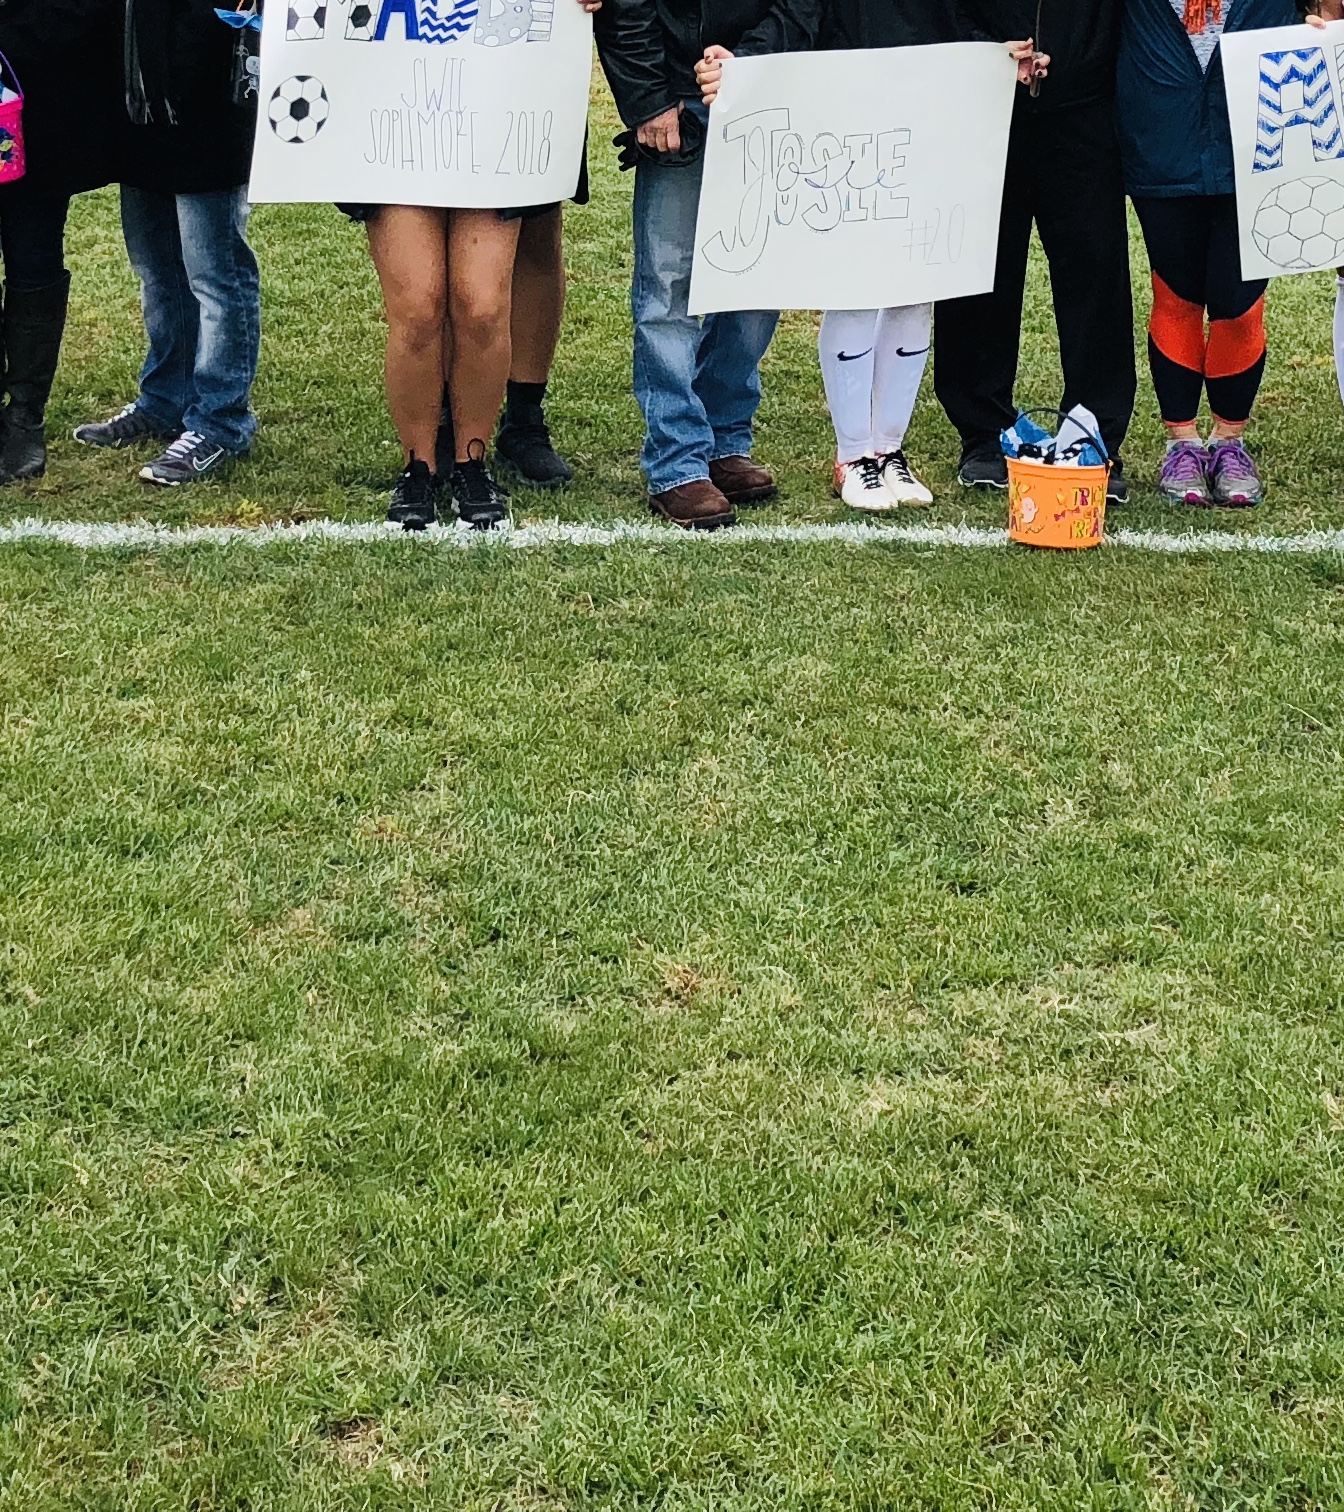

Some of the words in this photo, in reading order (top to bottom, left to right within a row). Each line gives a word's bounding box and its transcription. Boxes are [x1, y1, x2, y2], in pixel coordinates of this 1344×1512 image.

[400, 57, 467, 115] SWIC
[494, 109, 554, 176] 2018
[901, 203, 965, 266] #20
